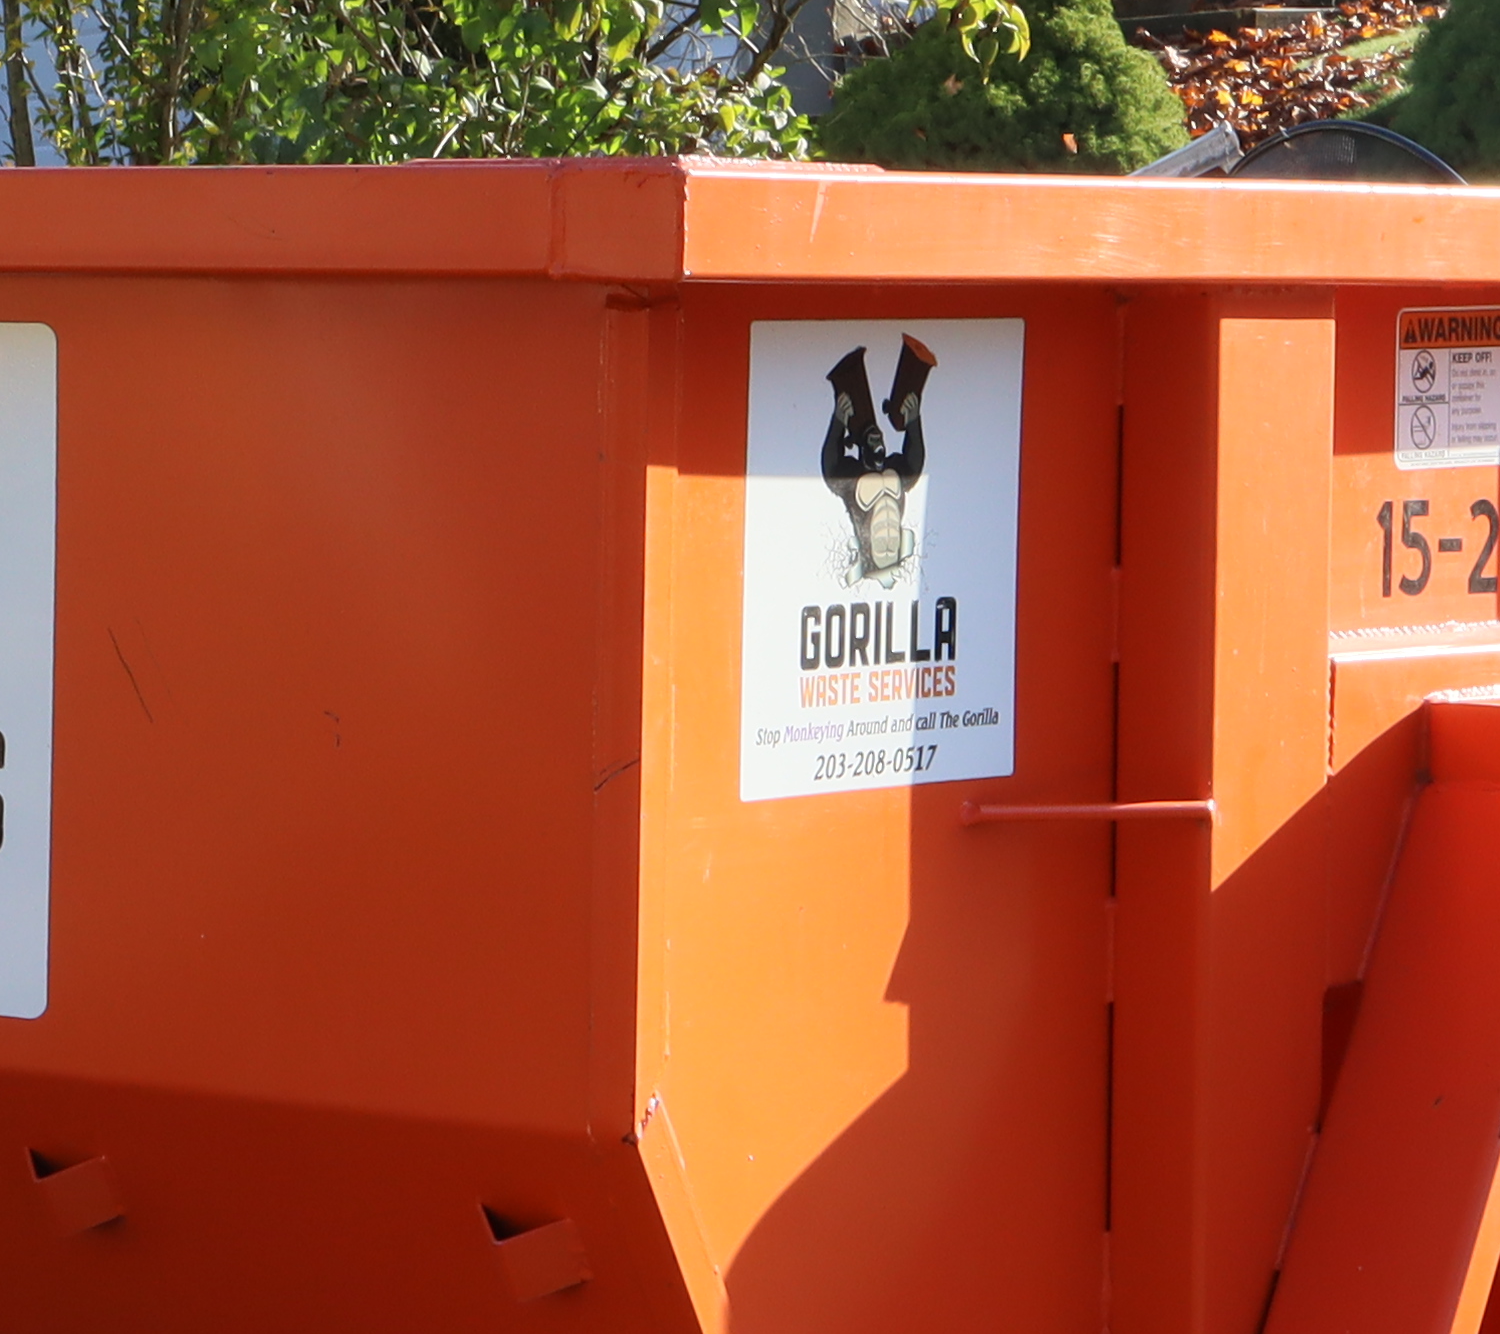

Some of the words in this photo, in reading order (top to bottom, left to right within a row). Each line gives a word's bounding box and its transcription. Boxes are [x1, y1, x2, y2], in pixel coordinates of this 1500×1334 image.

[1452, 352, 1474, 364] KEEP
[800, 596, 957, 671] GORILLA
[800, 672, 861, 708] WASTE
[868, 665, 956, 703] SERVICES
[756, 728, 781, 748] Stop
[783, 721, 844, 744] Monkeying
[847, 716, 888, 737] Around
[891, 713, 914, 733] and
[915, 712, 936, 731] call
[940, 711, 959, 729] The
[962, 708, 1000, 727] Gorilla
[814, 744, 938, 781] 203-208-0517
